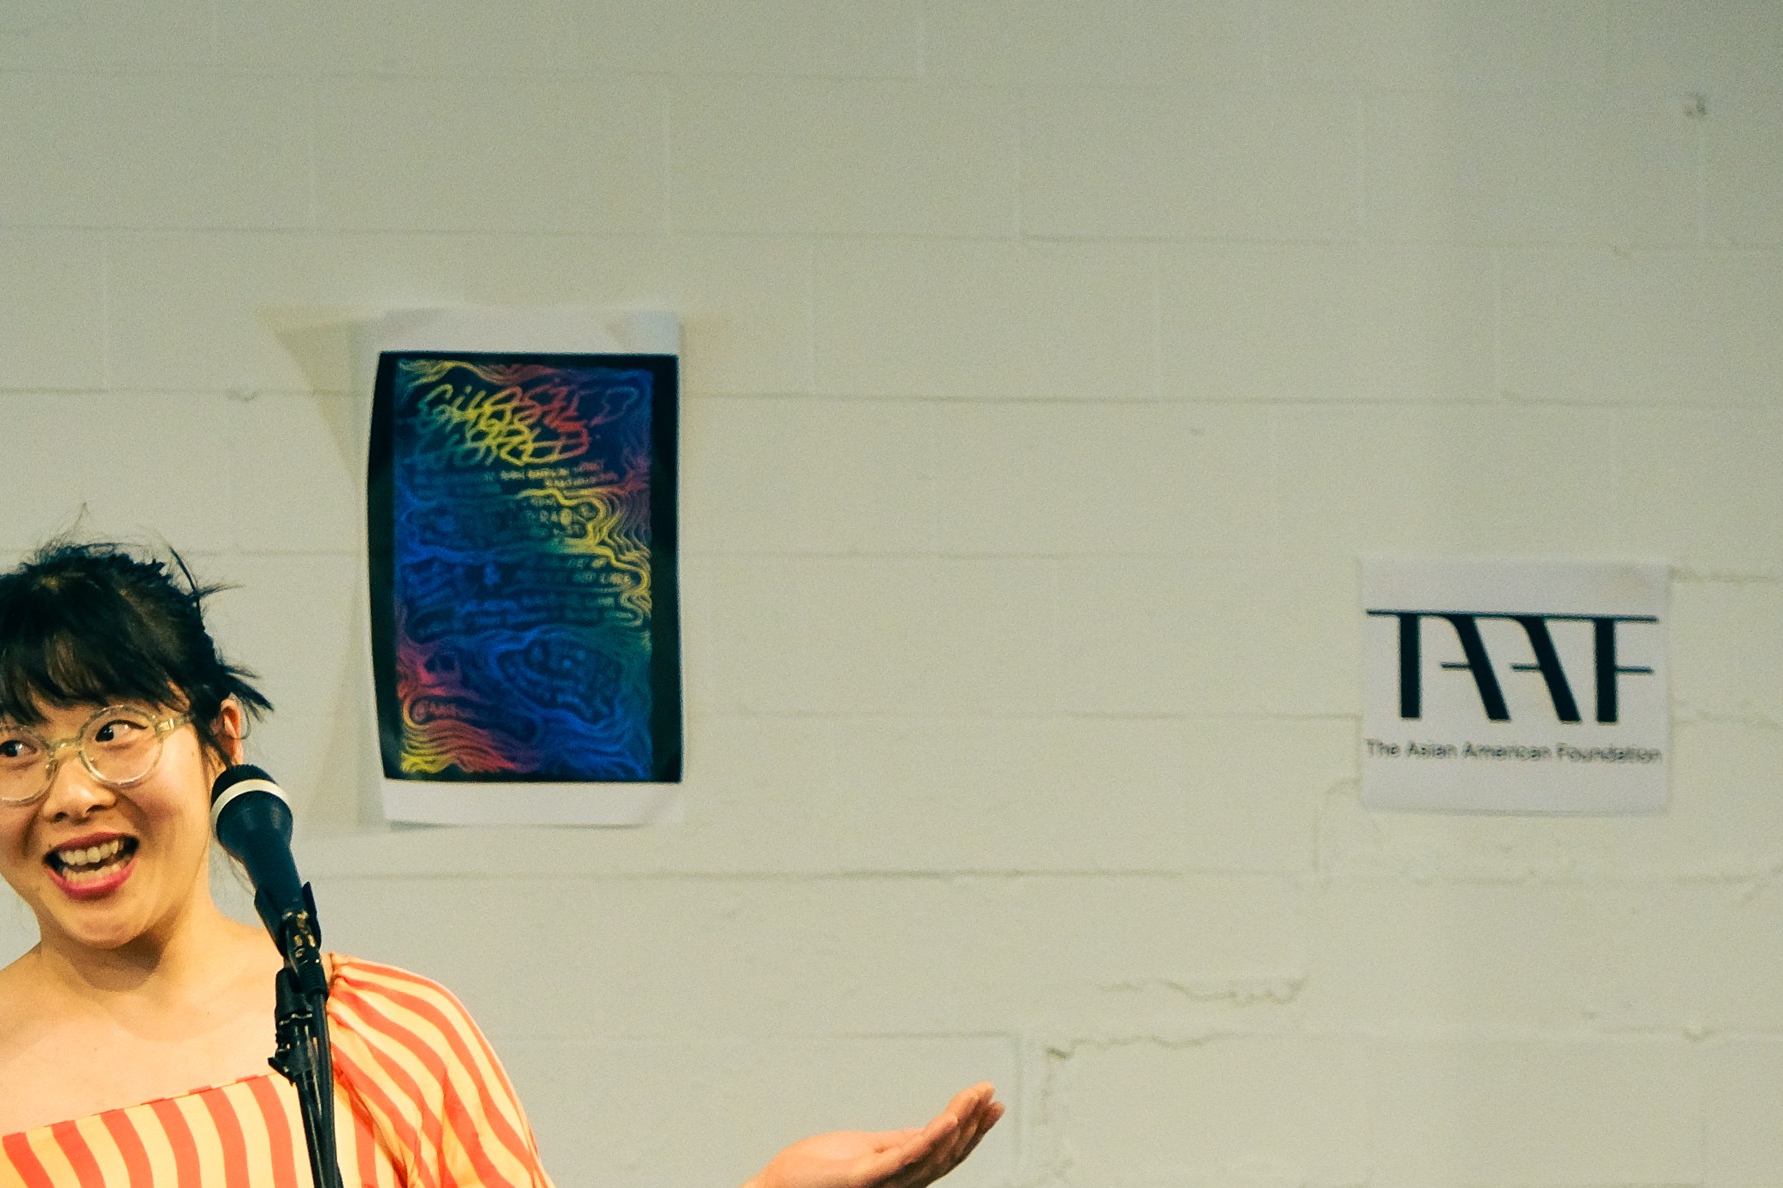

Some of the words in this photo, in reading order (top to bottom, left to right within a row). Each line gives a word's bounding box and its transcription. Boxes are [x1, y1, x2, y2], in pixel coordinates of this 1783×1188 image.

[1366, 609, 1659, 725] TAAF
[1365, 739, 1400, 758] The
[1406, 741, 1457, 760] Asian
[1463, 741, 1552, 762] American
[1556, 742, 1663, 764] Foundation
